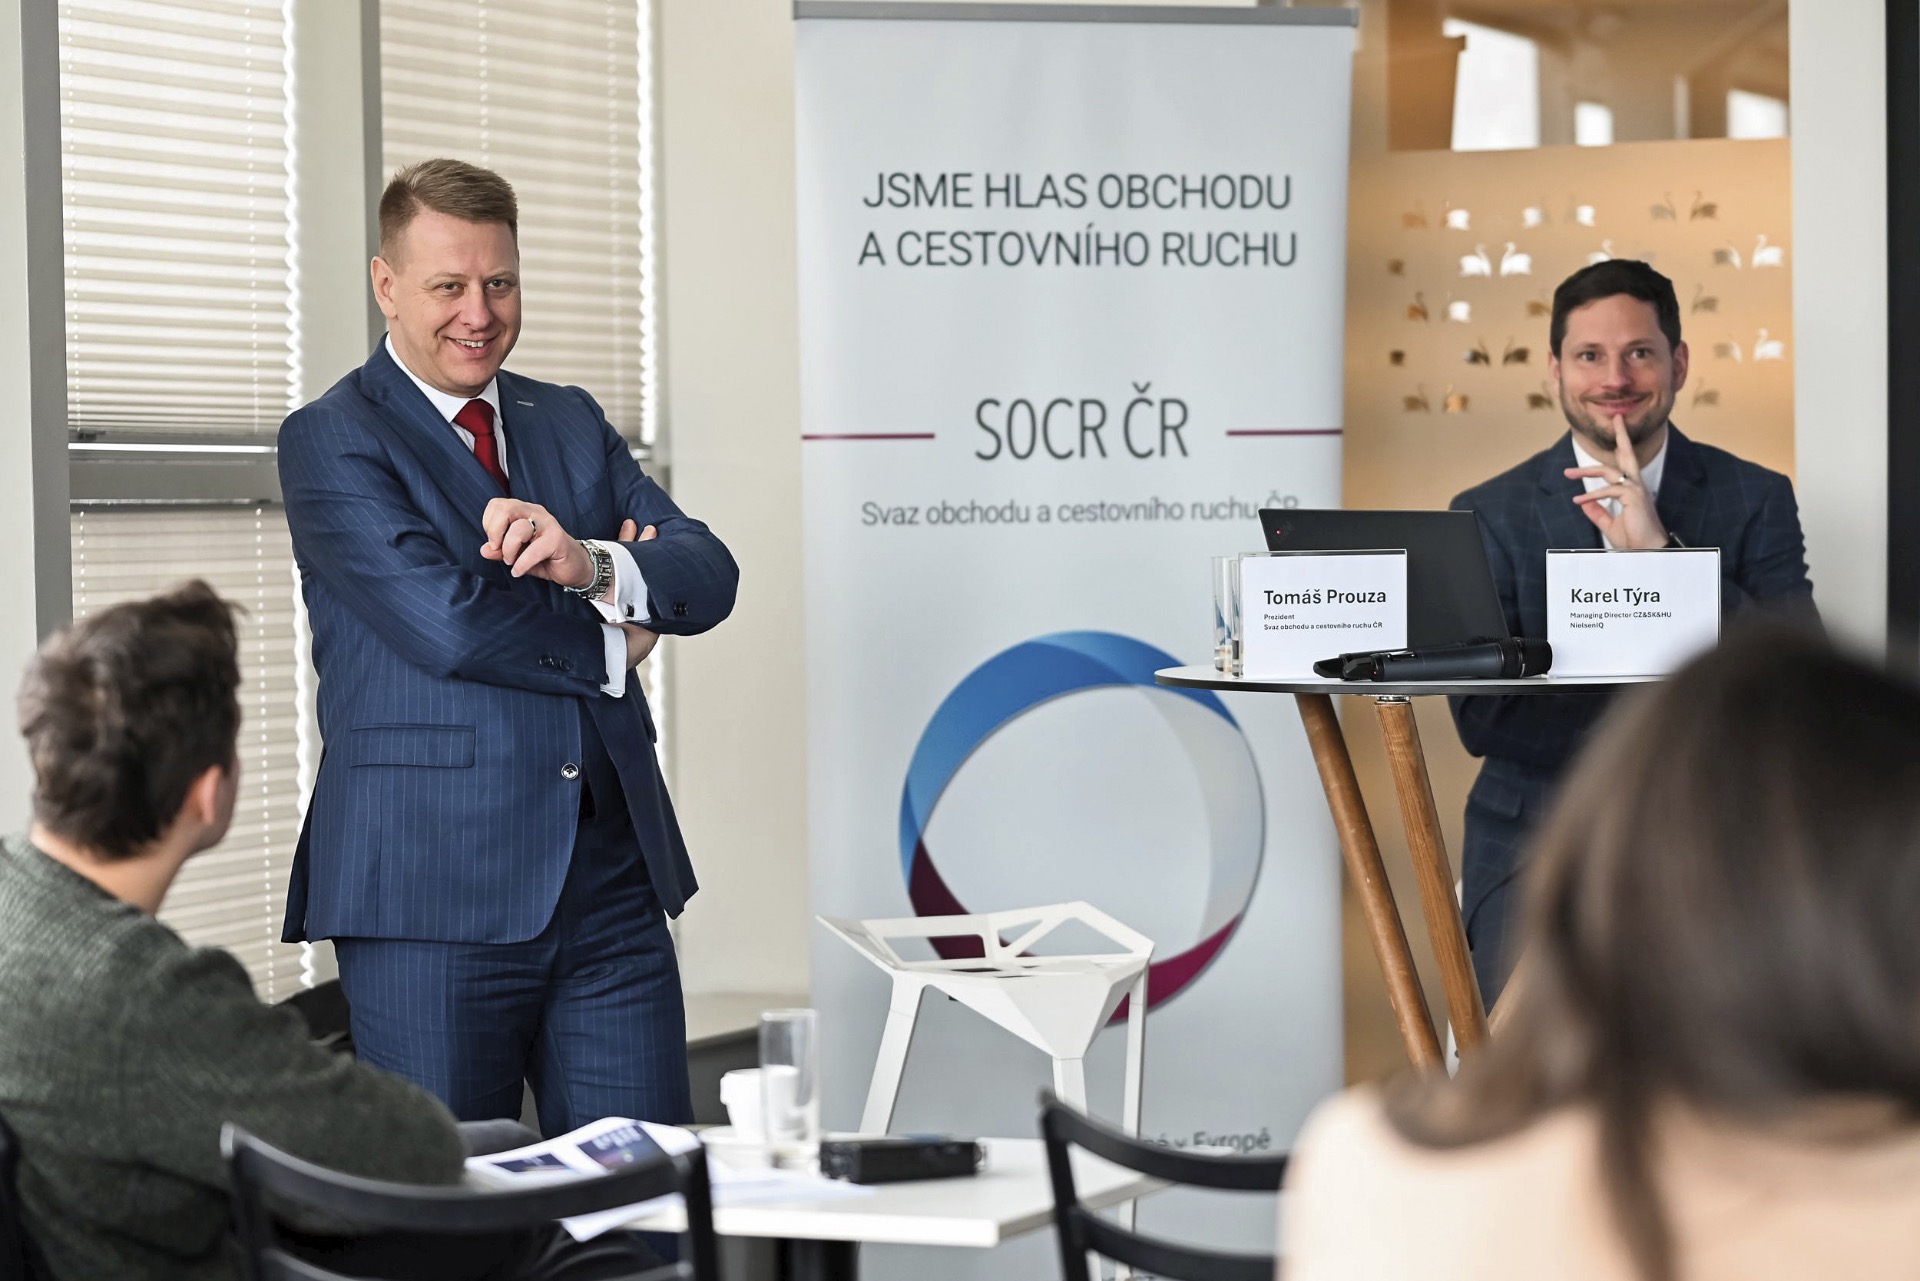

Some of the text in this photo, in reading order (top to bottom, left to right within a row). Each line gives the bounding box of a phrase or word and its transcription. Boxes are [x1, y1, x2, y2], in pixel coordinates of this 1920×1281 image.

[862, 172, 1293, 210] JSME HLAS OBCHODU
[857, 222, 1298, 268] A CESTOVNÍHO RUCHU
[974, 381, 1190, 462] SOCR ČR
[861, 501, 920, 527] Svaz
[925, 498, 1031, 526] obchodu
[1036, 504, 1052, 524] a
[1057, 495, 1186, 524] cestovního
[1190, 495, 1259, 522] ruchu
[1263, 588, 1387, 605] Tomáš Prouza
[1571, 587, 1661, 607] Karel Týra
[1263, 613, 1295, 621] Prezident
[1569, 612, 1603, 620] Managing
[1603, 611, 1632, 619] Director
[1263, 623, 1279, 631] Svaz
[1315, 622, 1352, 630] cestovního
[1372, 620, 1383, 629] ČR
[1569, 621, 1605, 630] NielsenIQ
